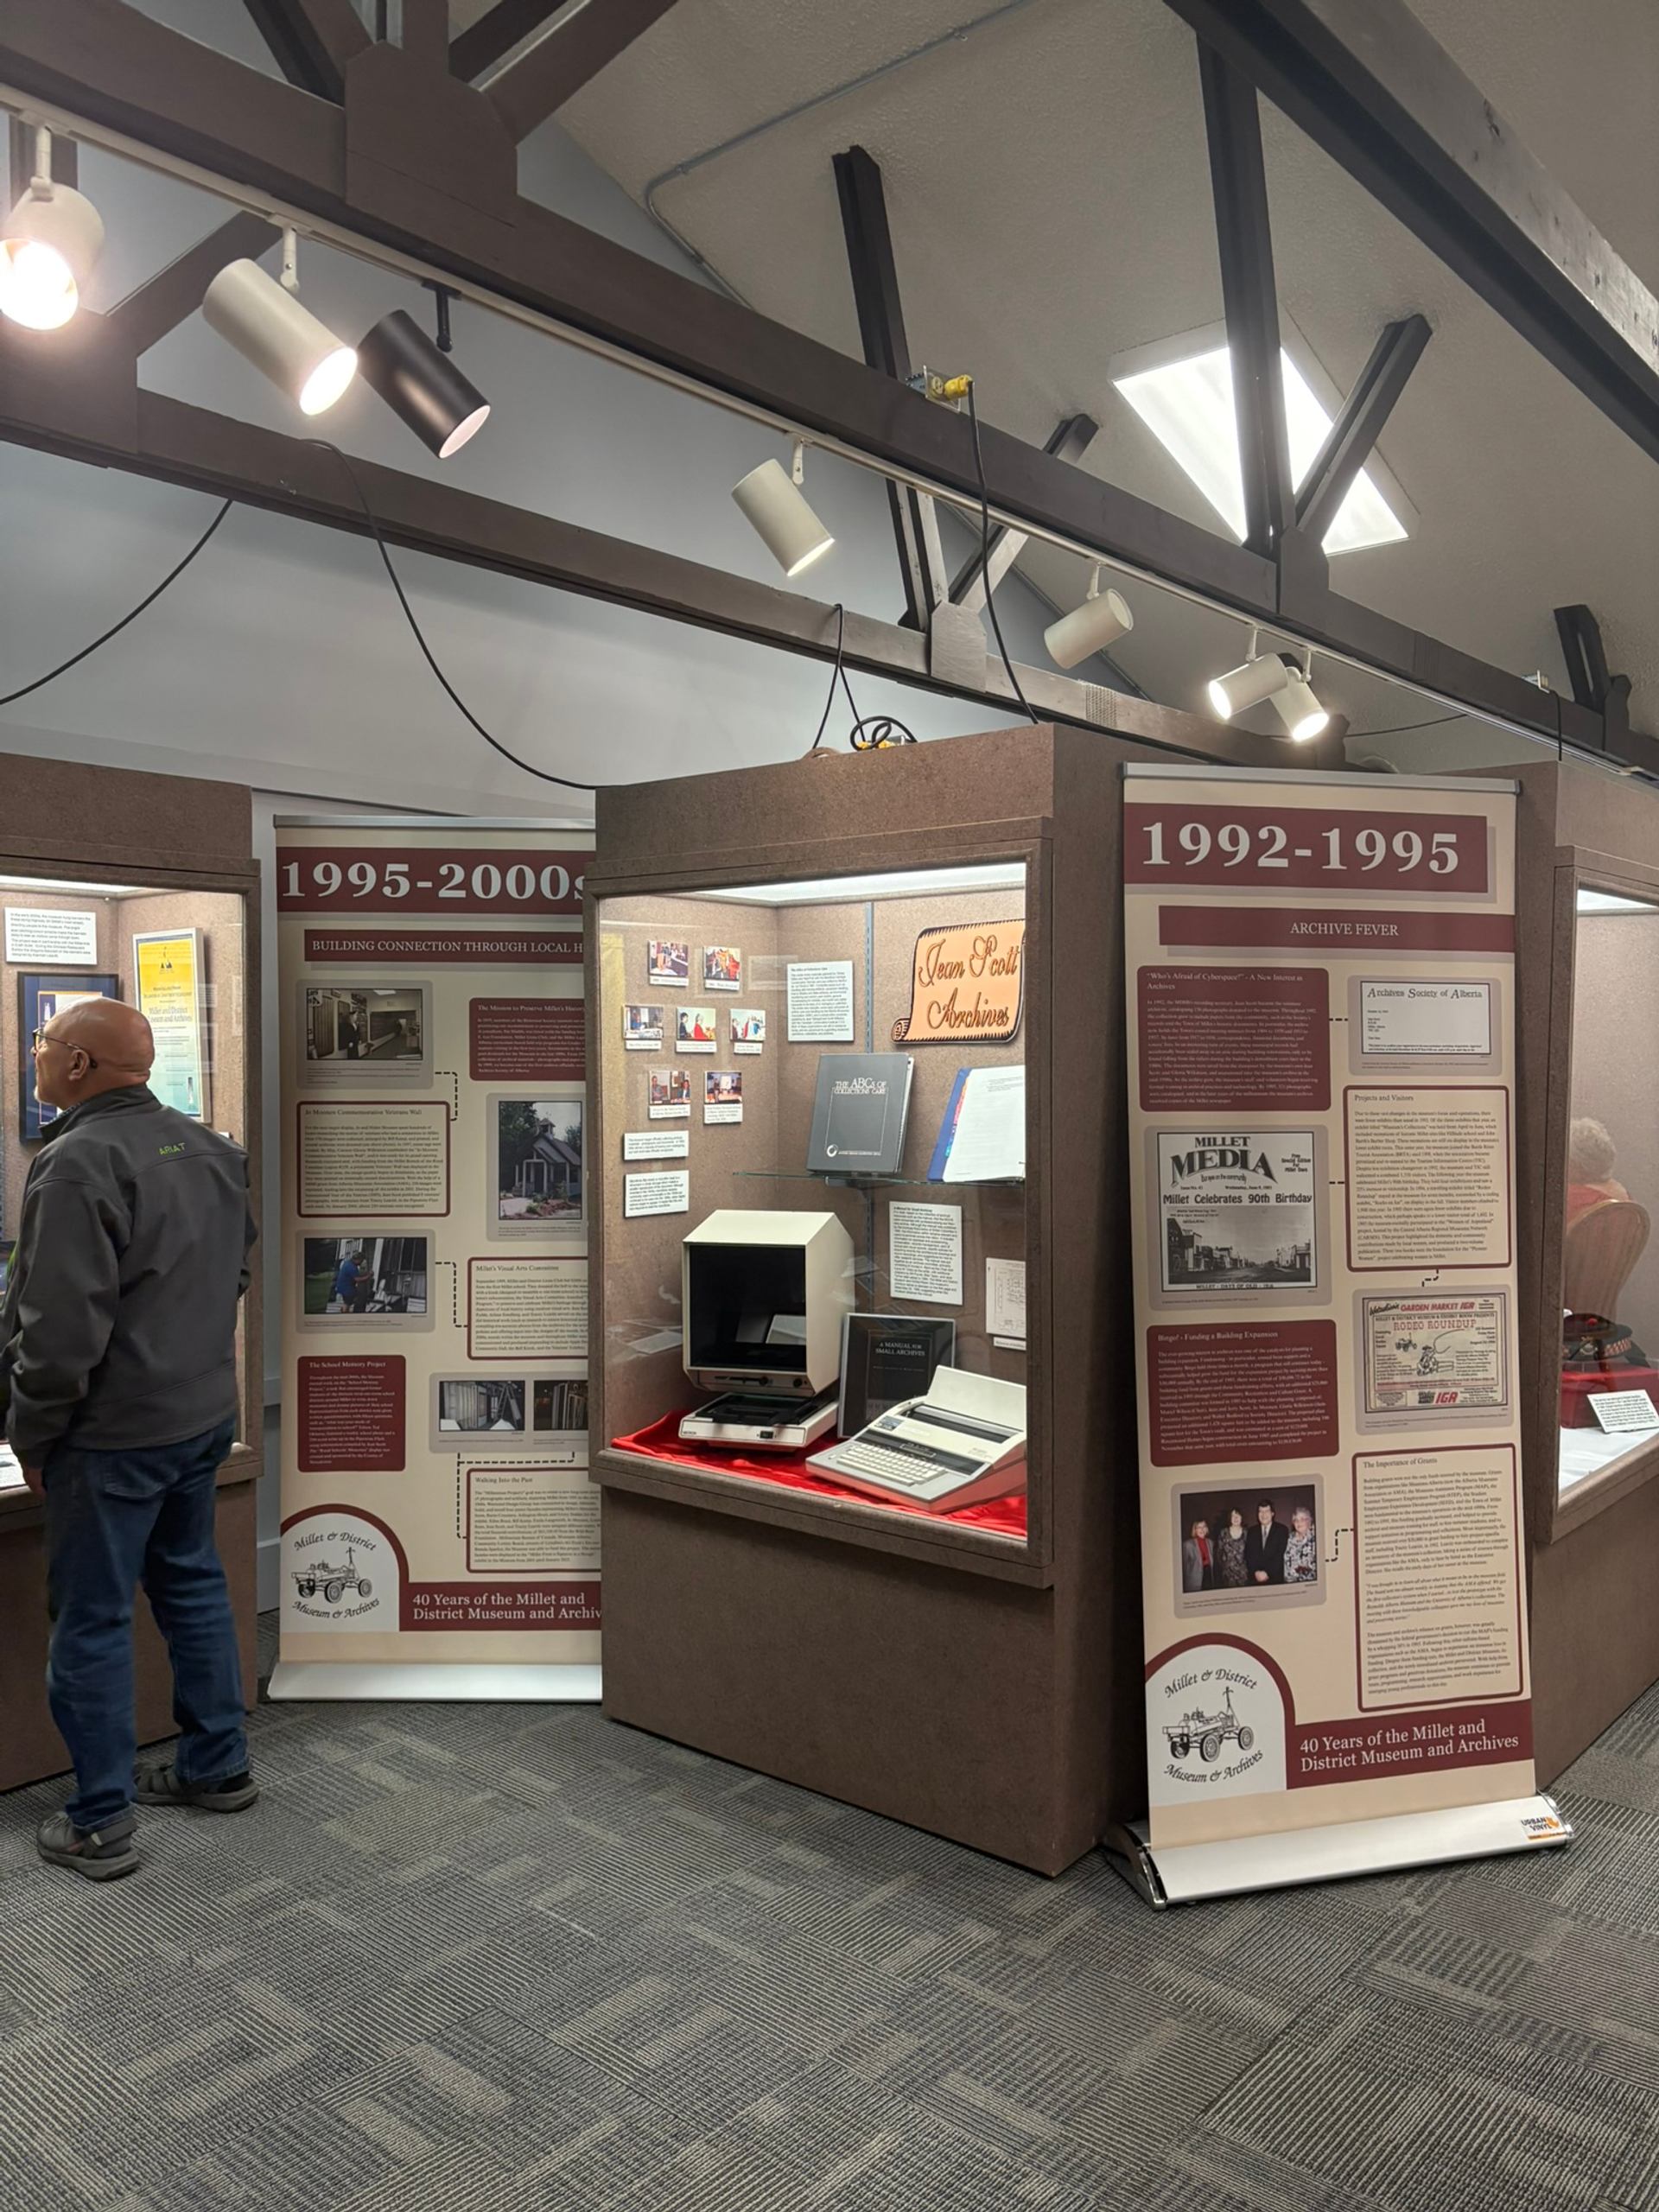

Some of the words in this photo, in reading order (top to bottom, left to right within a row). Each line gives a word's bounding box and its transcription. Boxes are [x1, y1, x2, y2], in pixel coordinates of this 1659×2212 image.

[1142, 822, 1459, 874] 1992-1995
[1290, 922, 1352, 934] ARCHIVE
[1357, 924, 1400, 936] FEVER
[312, 940, 375, 951] BUILDING
[378, 940, 461, 952] CONNECTION
[464, 941, 528, 953] THROUGH
[531, 942, 571, 953] LOCAL
[918, 938, 965, 988] Jean
[969, 935, 1020, 977] Scott
[1367, 988, 1405, 998] Archives
[1408, 988, 1438, 999] Society
[1451, 989, 1483, 999] Alberta
[928, 987, 1009, 1030] Archives
[1195, 1136, 1250, 1147] MILLET
[1171, 1149, 1278, 1188] MEDIA
[1163, 1194, 1190, 1205] Millet
[1194, 1194, 1243, 1205] Celebrates
[1248, 1193, 1270, 1204] 90th
[1275, 1193, 1312, 1205] Birthday
[1394, 1321, 1424, 1332] RODEO
[1428, 1319, 1477, 1330] ROUNDUP
[1435, 1392, 1459, 1404] IGA
[1376, 1459, 1408, 1468] Importance
[294, 1533, 324, 1552] Millet
[327, 1530, 338, 1541] &
[340, 1532, 377, 1551] District
[412, 1594, 429, 1605] 40
[434, 1593, 470, 1605] Years
[474, 1593, 486, 1605] of
[491, 1593, 512, 1605] the
[517, 1593, 556, 1605] Millet
[560, 1593, 585, 1605] and
[291, 1600, 330, 1618] Museum
[332, 1610, 343, 1618] &
[344, 1598, 379, 1618] Archives
[414, 1608, 464, 1620] District
[467, 1608, 525, 1619] Museum
[530, 1607, 555, 1619] and
[1165, 1673, 1198, 1698] Millet
[1201, 1669, 1213, 1681] &
[1215, 1669, 1258, 1689] District
[1300, 1738, 1319, 1753] 40
[1322, 1733, 1363, 1751] Years
[1368, 1731, 1382, 1746] of
[1385, 1728, 1408, 1744] the
[1412, 1723, 1454, 1741] Millet
[1459, 1719, 1486, 1736] and
[1300, 1753, 1357, 1772] District
[1361, 1746, 1423, 1765] Museum
[1427, 1741, 1453, 1758] and
[1458, 1733, 1519, 1753] Archives
[1164, 1764, 1207, 1783] Museum
[1209, 1770, 1223, 1782] &
[1223, 1750, 1263, 1780] Archives
[1520, 1817, 1547, 1826] URBAN
